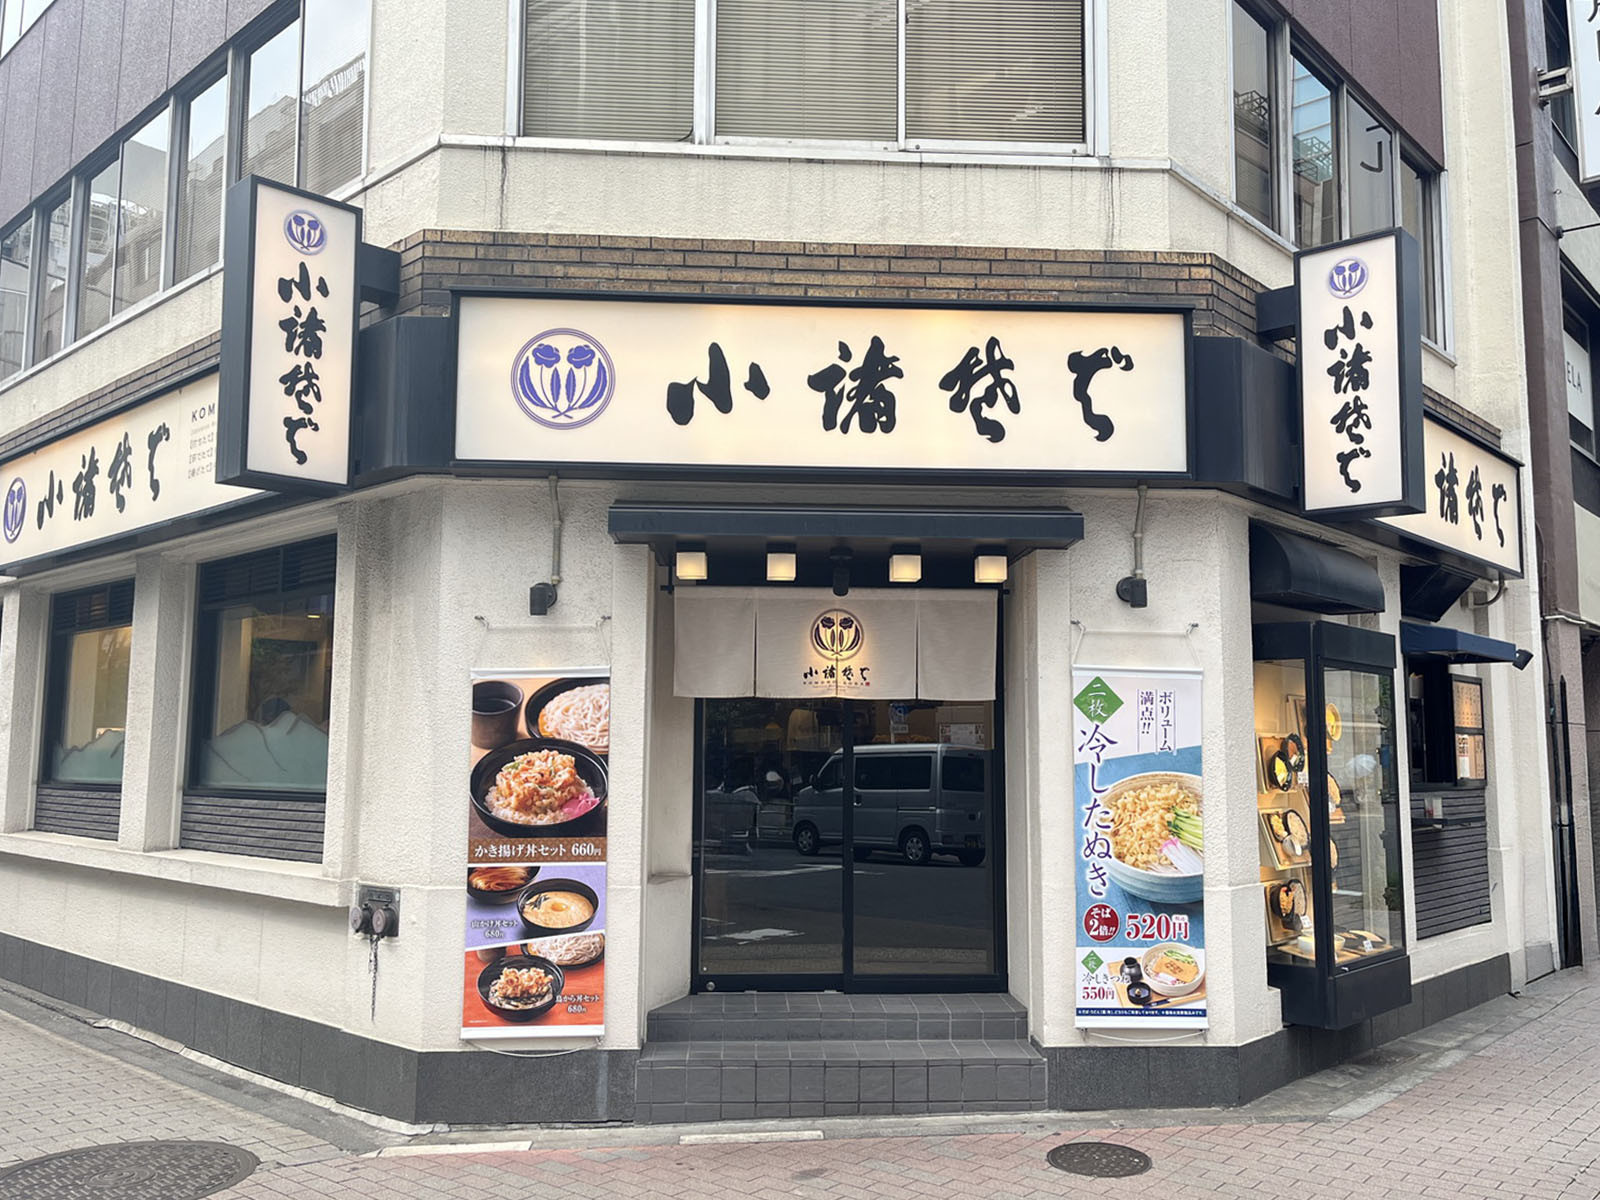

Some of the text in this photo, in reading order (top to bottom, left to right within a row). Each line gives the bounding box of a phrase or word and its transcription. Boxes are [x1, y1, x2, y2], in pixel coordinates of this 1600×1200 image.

[1088, 684, 1108, 717] 二枚
[1159, 691, 1173, 751] ボリューム
[1078, 724, 1118, 896] 冷したぬき
[474, 843, 601, 857] かき揚げ丼セット 660円
[1091, 907, 1111, 918] そば
[1126, 914, 1188, 939] 520円
[1082, 986, 1114, 1000] 550円
